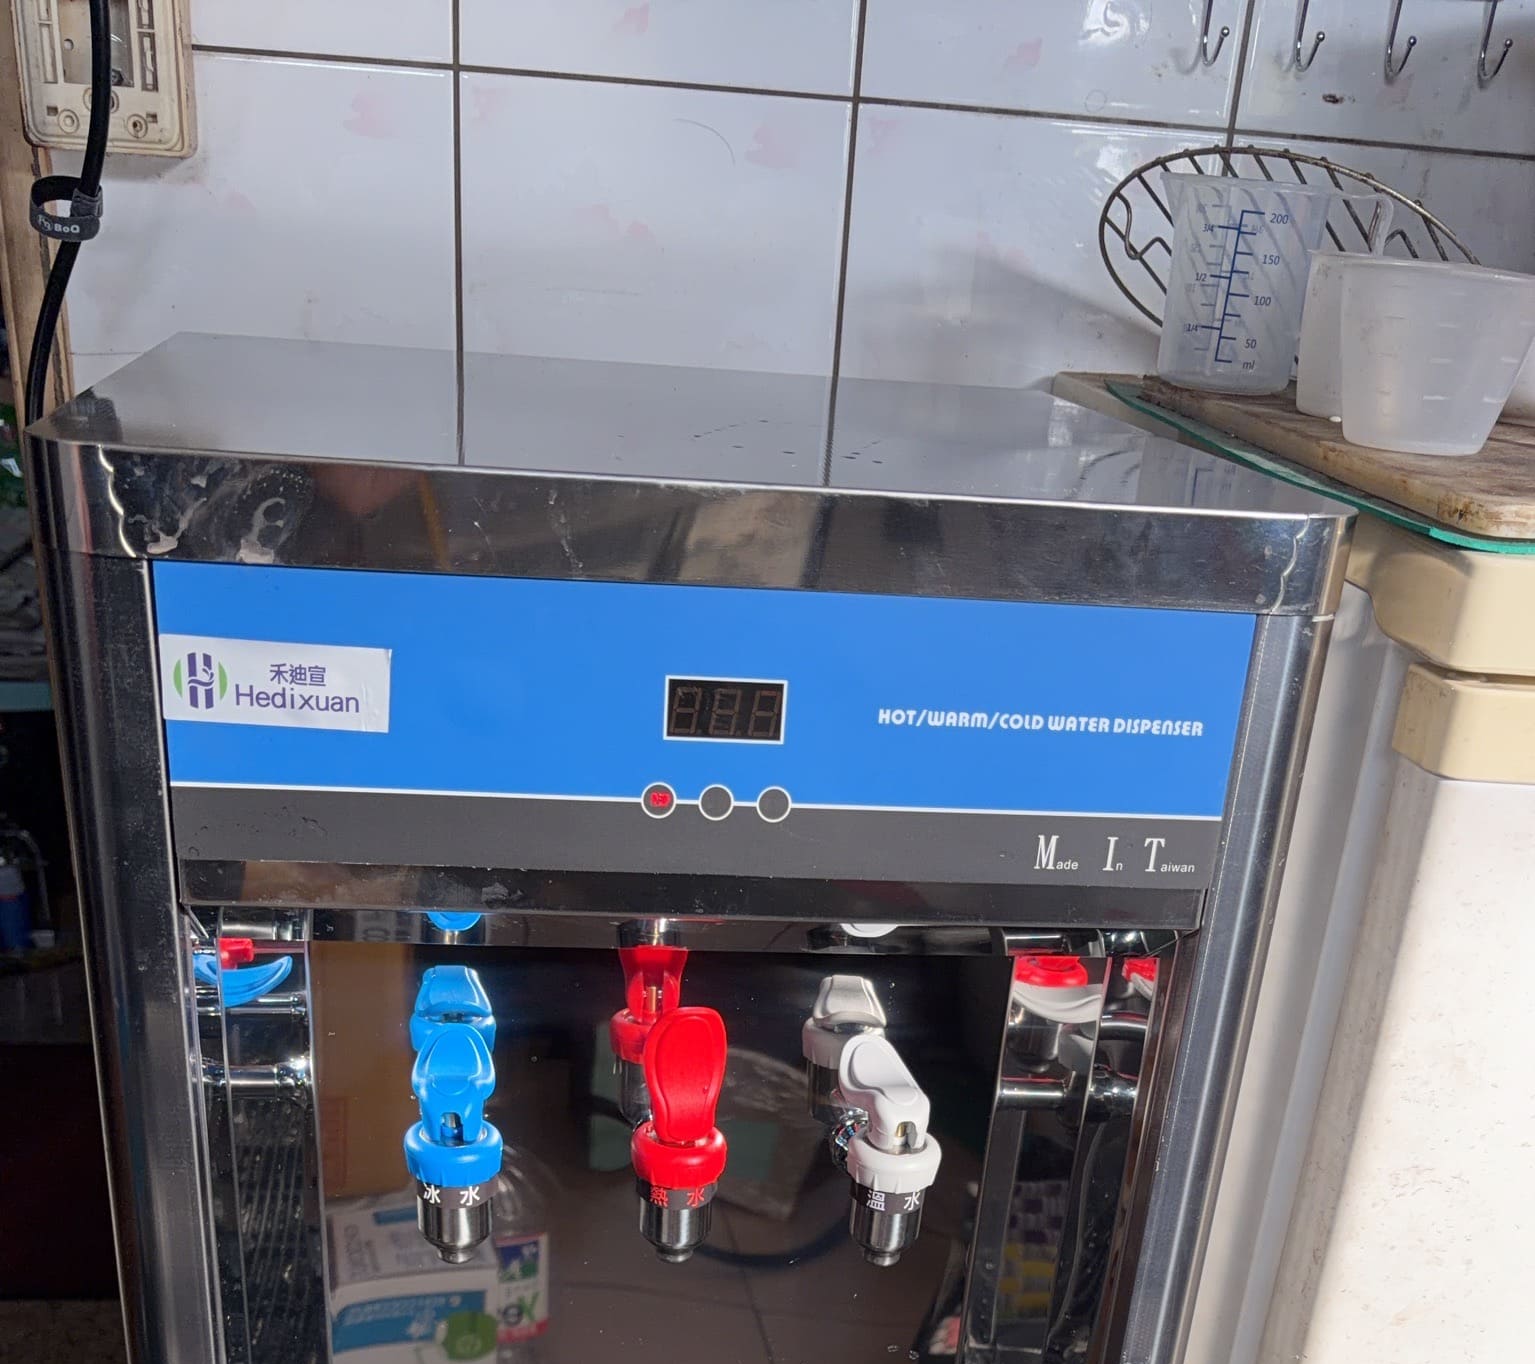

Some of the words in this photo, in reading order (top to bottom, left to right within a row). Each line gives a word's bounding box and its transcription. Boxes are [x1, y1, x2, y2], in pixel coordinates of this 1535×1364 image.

[1270, 213, 1289, 225] 200
[1202, 223, 1215, 233] 3/4
[1262, 254, 1280, 266] 150
[1195, 272, 1207, 282] 1/2
[1254, 296, 1272, 306] 100
[1186, 322, 1199, 332] 1/4
[1244, 338, 1257, 349] 50
[1242, 361, 1256, 370] ml
[269, 663, 326, 687] 禾迪宣
[235, 684, 360, 713] Hedixuan
[877, 708, 1045, 730] HOT/WARM/COLD
[1047, 714, 1110, 733] WATER
[1113, 719, 1203, 736] DISPENSER
[1033, 834, 1079, 870] Made
[1102, 836, 1124, 871] In
[1144, 837, 1196, 873] Taiwan
